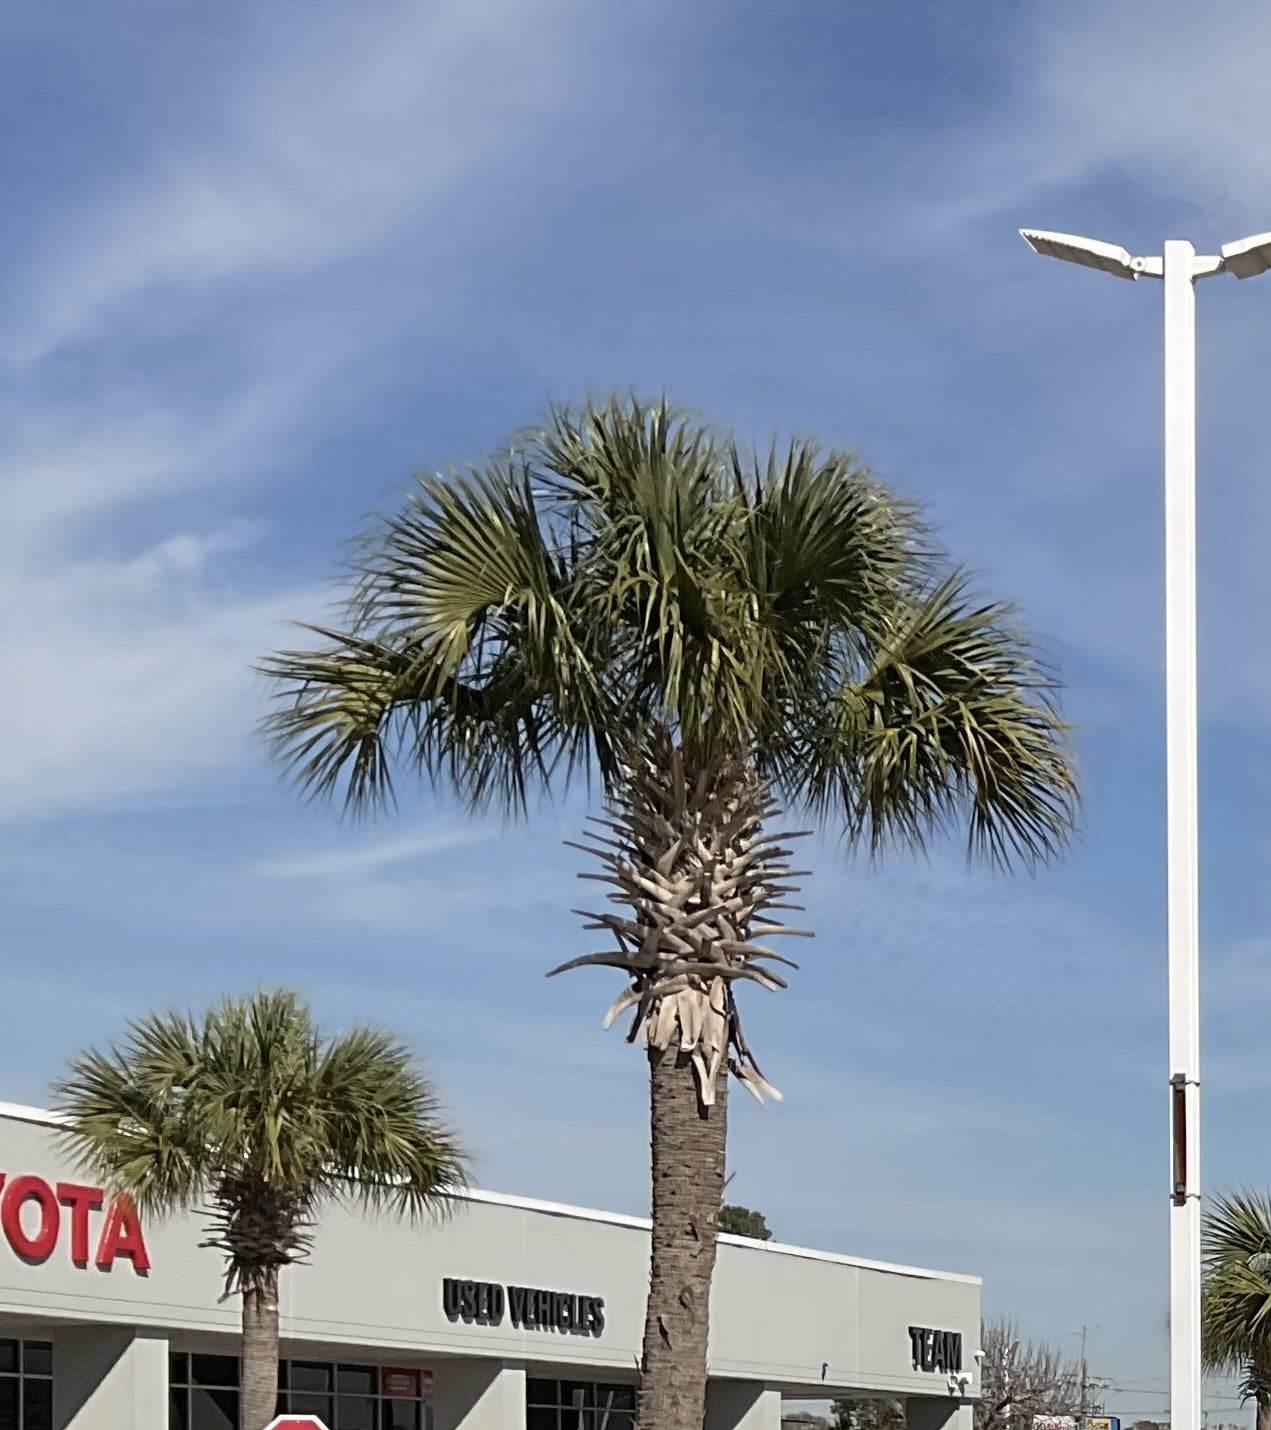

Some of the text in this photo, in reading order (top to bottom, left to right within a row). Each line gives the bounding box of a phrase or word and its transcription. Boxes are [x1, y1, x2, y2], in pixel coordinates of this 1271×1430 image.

[0, 1174, 150, 1276] OTA
[443, 1278, 605, 1337] USED VEHICLES
[908, 1325, 962, 1373] TEAM
